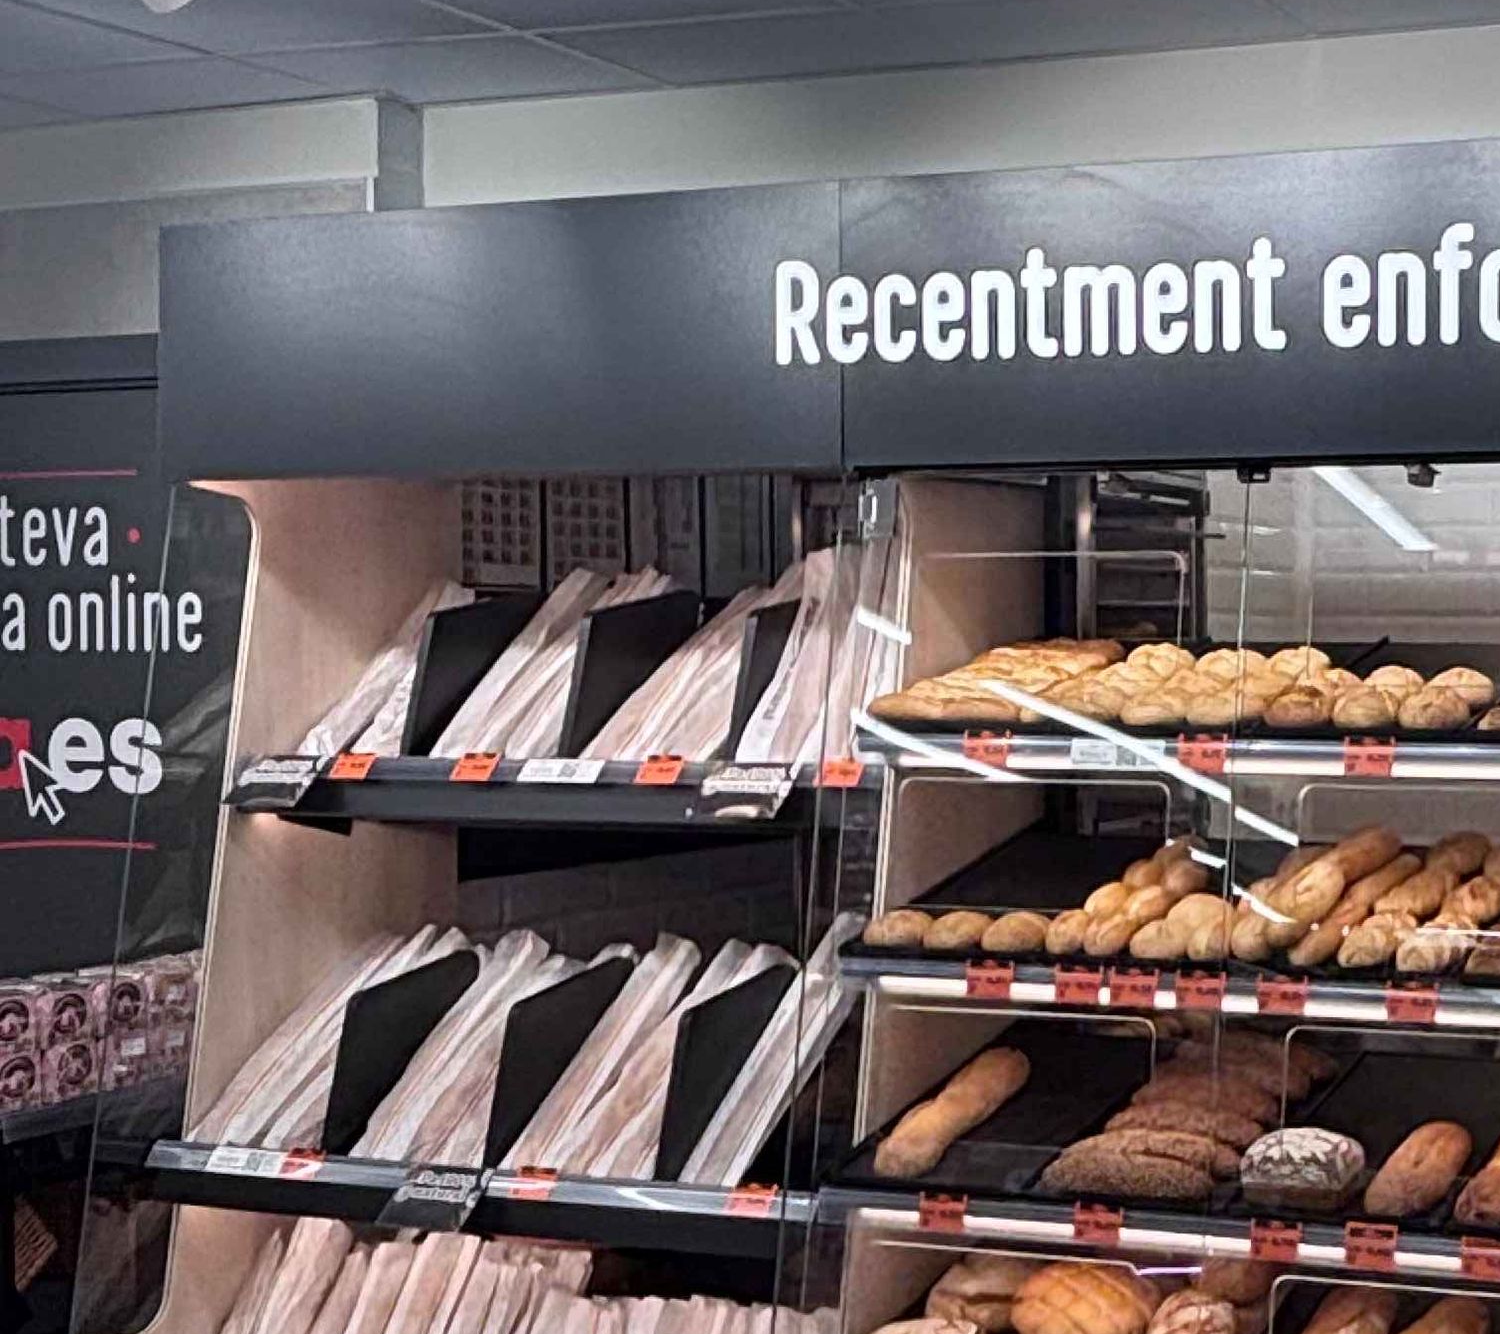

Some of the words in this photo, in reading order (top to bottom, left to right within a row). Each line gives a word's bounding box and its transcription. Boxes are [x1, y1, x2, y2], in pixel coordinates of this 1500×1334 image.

[775, 236, 1288, 365] Recentment
[0, 495, 109, 566] teva
[48, 573, 202, 652] online
